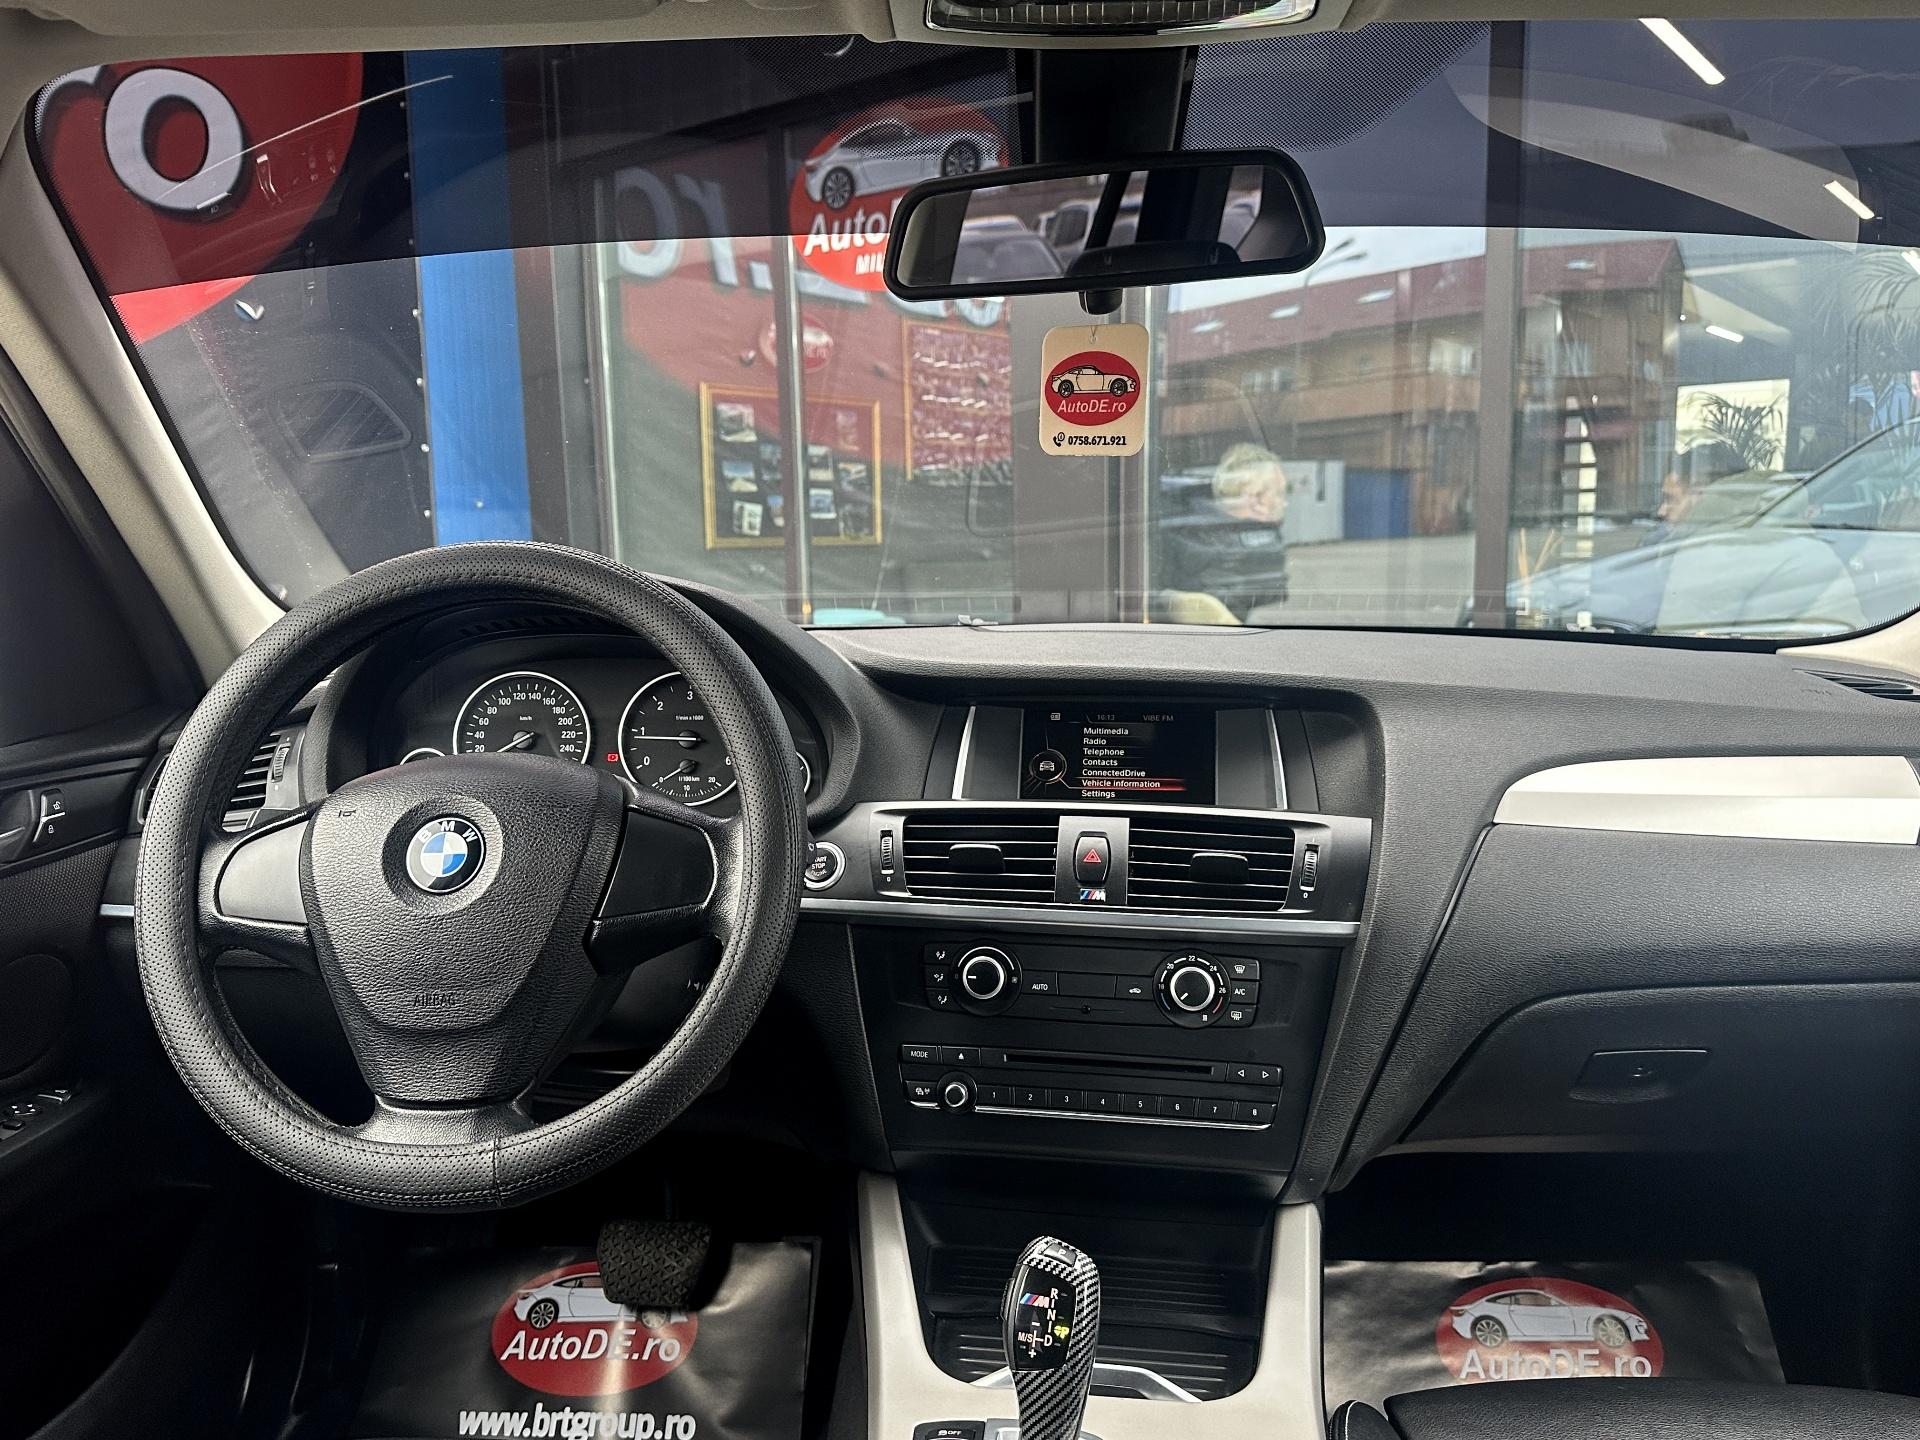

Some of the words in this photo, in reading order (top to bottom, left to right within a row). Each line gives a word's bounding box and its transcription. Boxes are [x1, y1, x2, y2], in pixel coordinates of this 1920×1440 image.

[803, 197, 903, 257] Auto
[1057, 399, 1127, 413] AutoDE.ro
[1068, 436, 1127, 446] 0758.671.921
[513, 692, 526, 700] 120
[528, 692, 541, 700] 140
[687, 691, 693, 700] 3
[487, 706, 498, 714] 80
[552, 706, 566, 714] 180
[657, 701, 664, 711] 2
[474, 731, 485, 739] 40
[640, 726, 645, 736] 1
[1083, 727, 1129, 735] Multimedia
[1083, 737, 1107, 745] Radio
[560, 744, 575, 752] 240
[1083, 747, 1125, 757] Telephone
[643, 756, 650, 766] 0
[725, 756, 732, 766] 6
[1082, 758, 1118, 766] Contacts
[1082, 768, 1146, 777] ConnectedDrive
[1082, 779, 1112, 787] Vehicle
[1081, 789, 1116, 798] Settings
[417, 820, 478, 843] BMW
[1031, 983, 1048, 991] AUTO
[1233, 988, 1246, 996] A/C
[910, 1050, 929, 1059] MODE
[992, 1091, 996, 1099] 1
[1028, 1093, 1033, 1101] 2
[1064, 1095, 1069, 1103] 3
[1100, 1098, 1105, 1106] 4
[1138, 1100, 1143, 1108] 5
[1175, 1103, 1180, 1111] 6
[1212, 1106, 1217, 1114] 7
[1252, 1108, 1257, 1116] 8
[1050, 1287, 1059, 1300] R
[1046, 1308, 1056, 1321] N
[1017, 1331, 1034, 1343] M/S
[1043, 1334, 1053, 1347] D
[501, 1329, 681, 1361] AutoDE.ro
[1459, 1349, 1652, 1379] AutoDEro
[458, 1403, 697, 1440] www.brtgroup.ro
